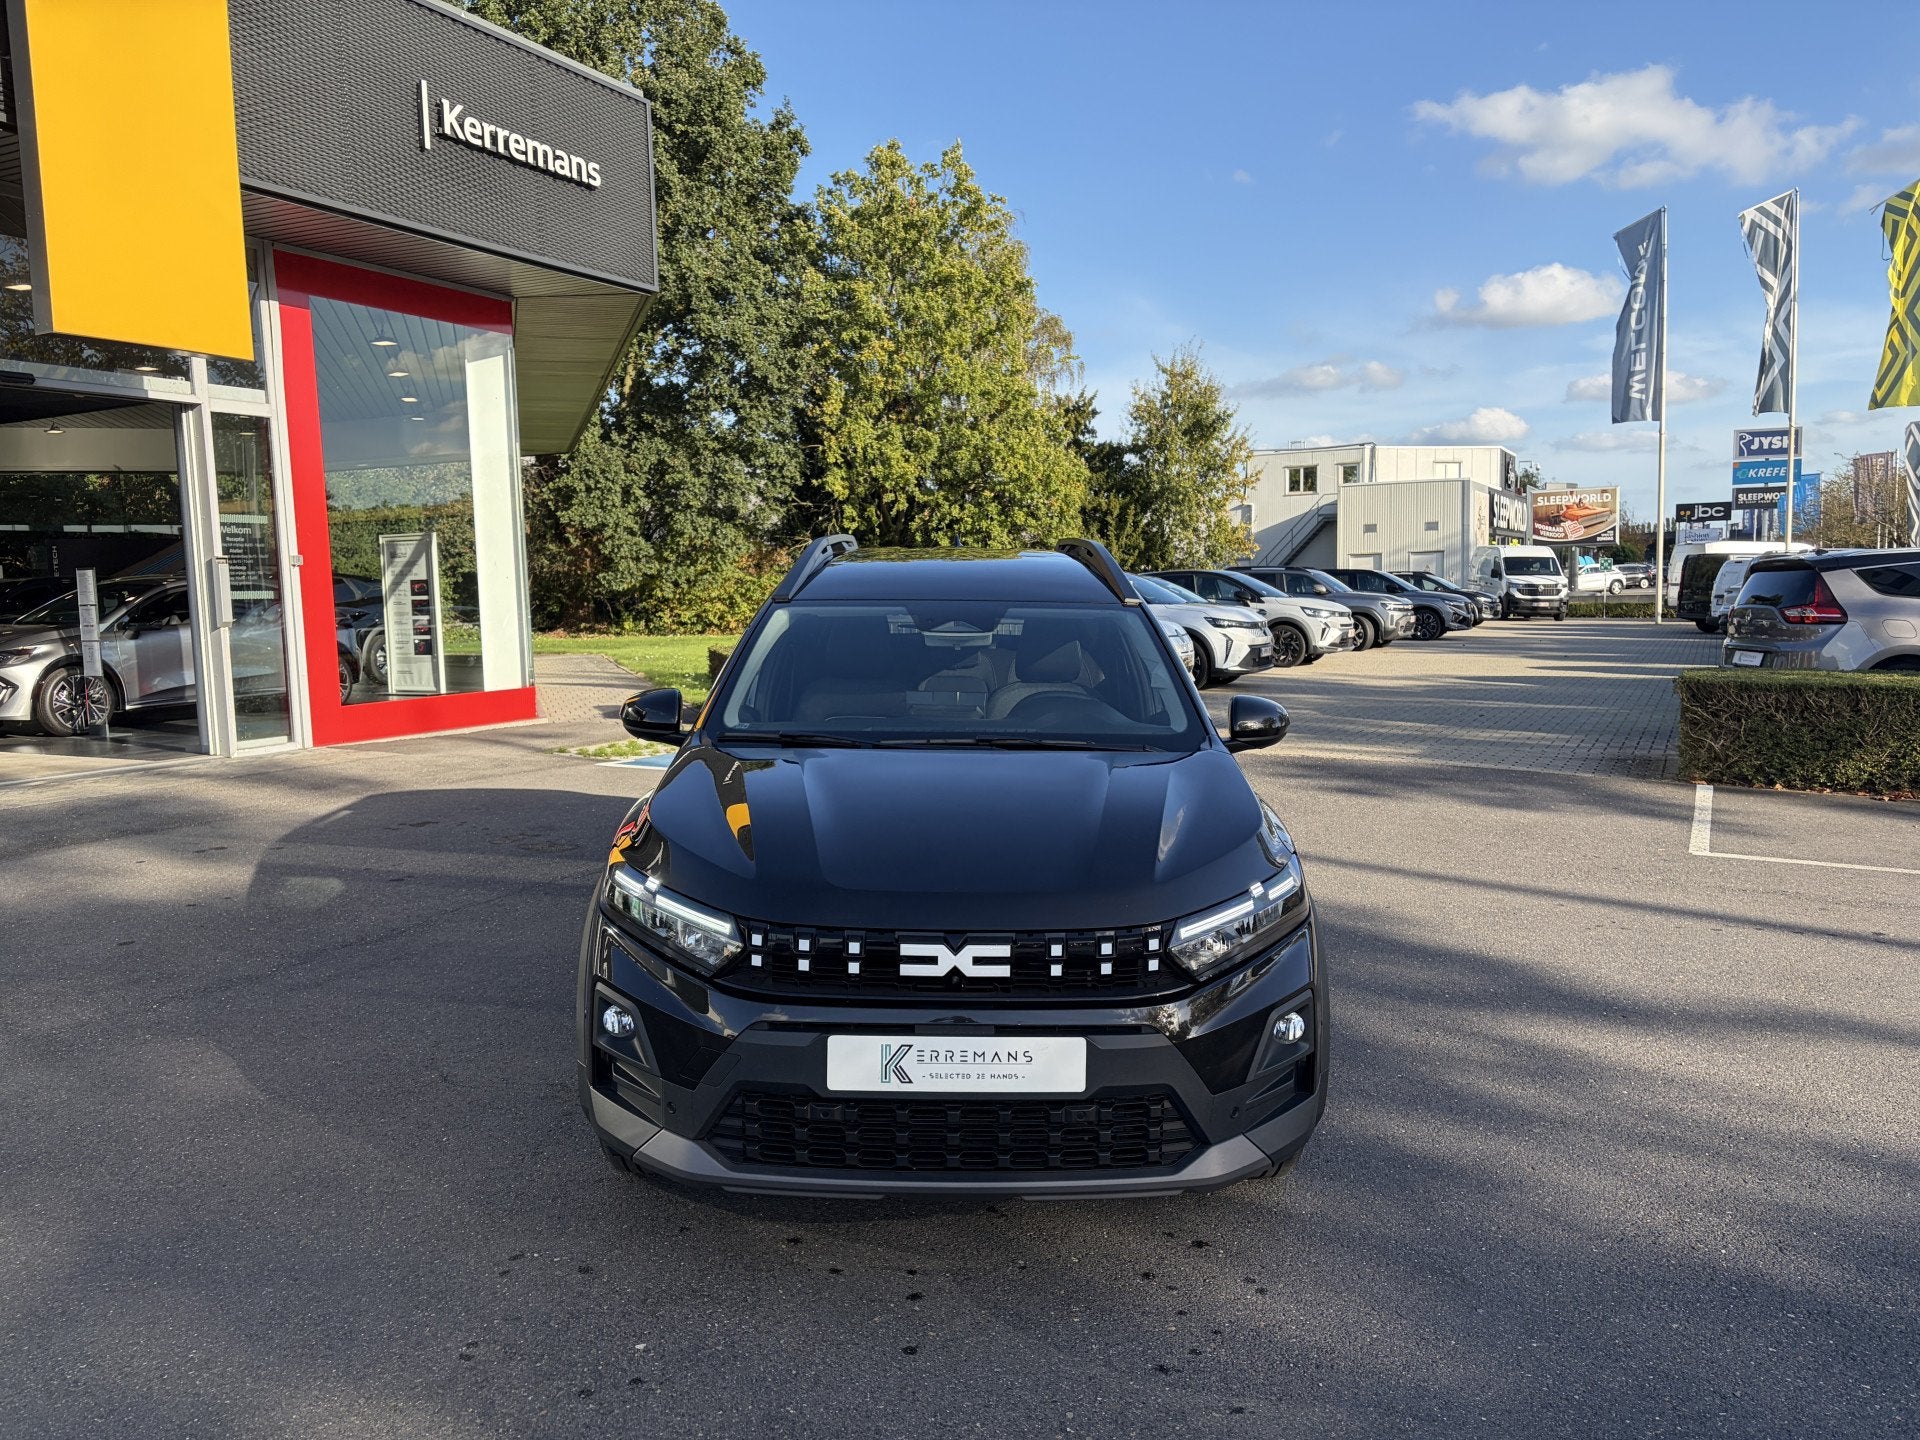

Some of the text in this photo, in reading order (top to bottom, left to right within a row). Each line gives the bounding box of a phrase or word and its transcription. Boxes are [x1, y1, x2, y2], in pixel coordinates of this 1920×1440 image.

[441, 98, 601, 187] Kerremans
[1748, 466, 1788, 478] KREFE
[1537, 492, 1612, 506] SLEEPWORLD
[1738, 492, 1785, 501] SLEEPWO
[1691, 505, 1725, 520] jbc
[51, 545, 60, 577] E-TECH
[880, 1043, 1034, 1084] KERREMANS
